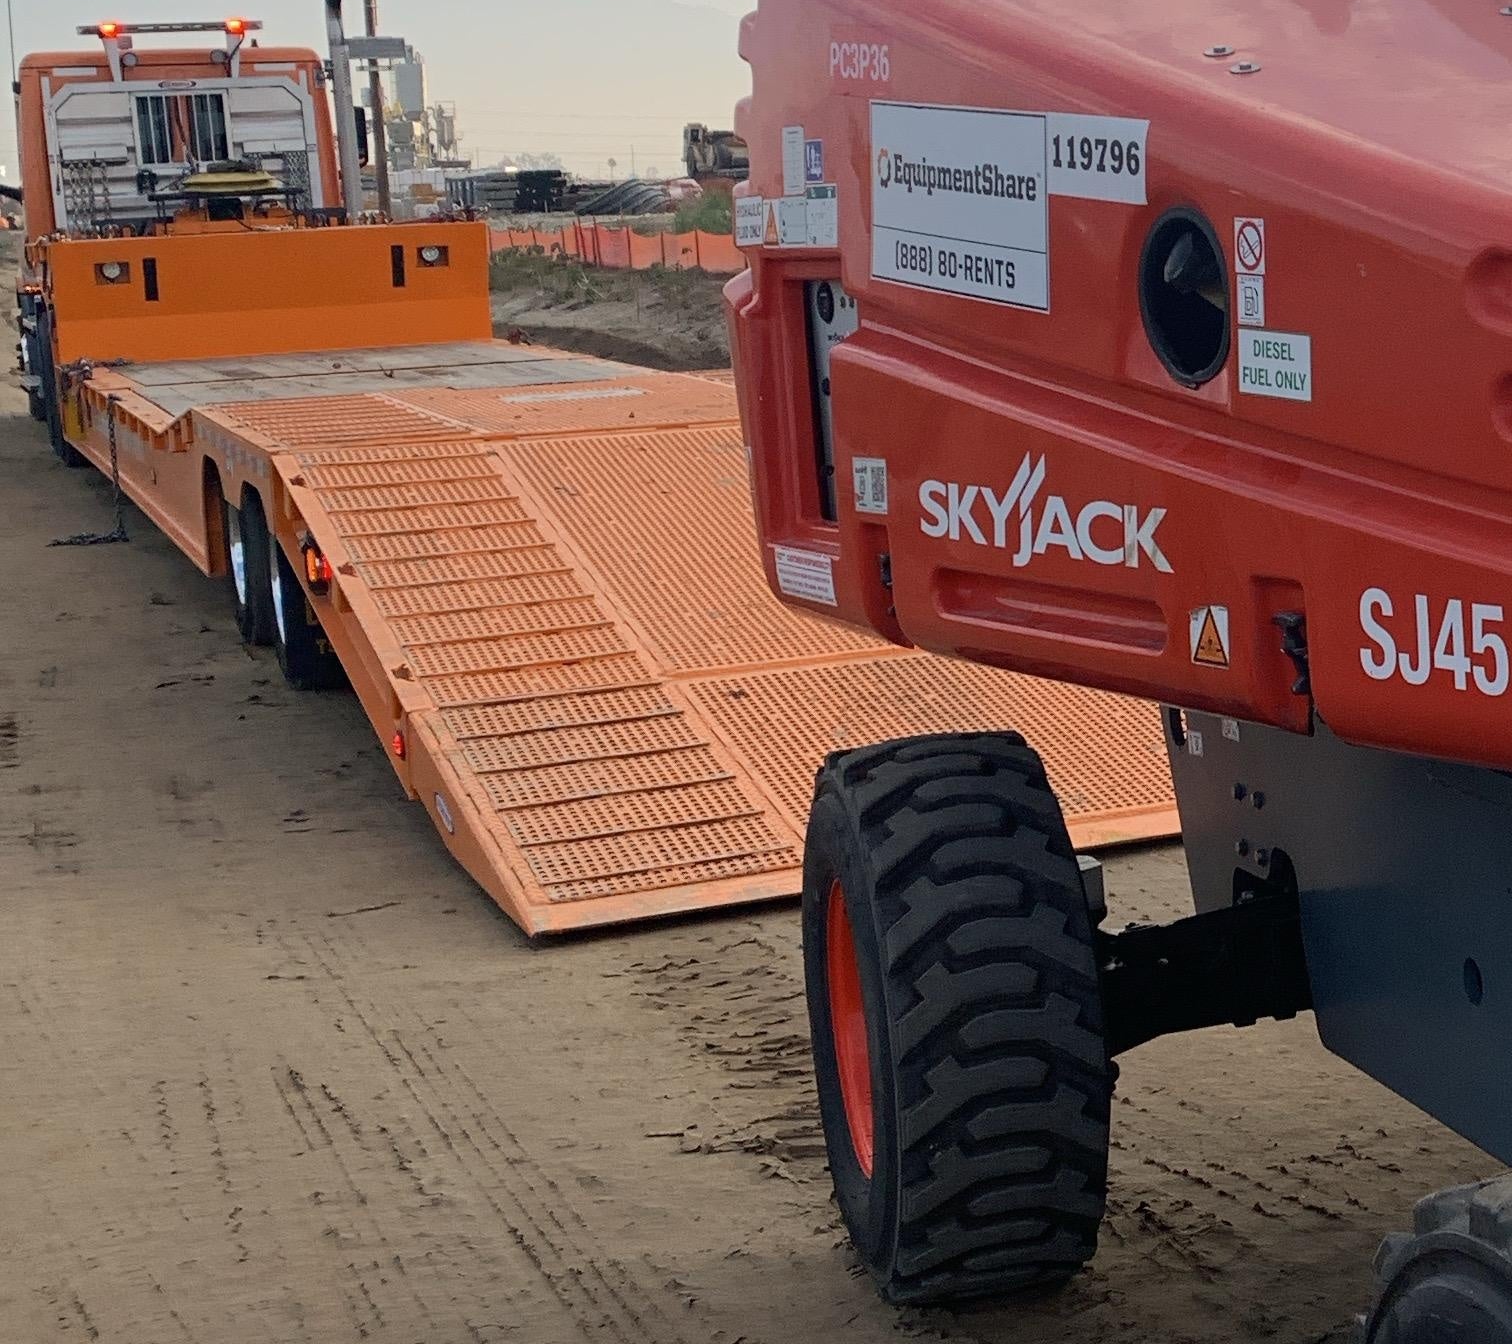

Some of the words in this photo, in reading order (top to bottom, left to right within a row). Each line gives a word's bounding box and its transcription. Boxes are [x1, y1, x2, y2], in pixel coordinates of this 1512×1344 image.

[829, 41, 890, 82] PC3P36
[893, 153, 1037, 202] EquipmentShare
[1052, 133, 1141, 176] 119796
[895, 240, 933, 277] (888)
[938, 249, 1016, 290] 80-RENTS
[1253, 339, 1296, 362] DIESEL
[1242, 365, 1273, 388] FUEL
[1275, 370, 1307, 392] ONLY
[918, 450, 1175, 574] SKYJACK
[1359, 586, 1510, 697] SJ45
